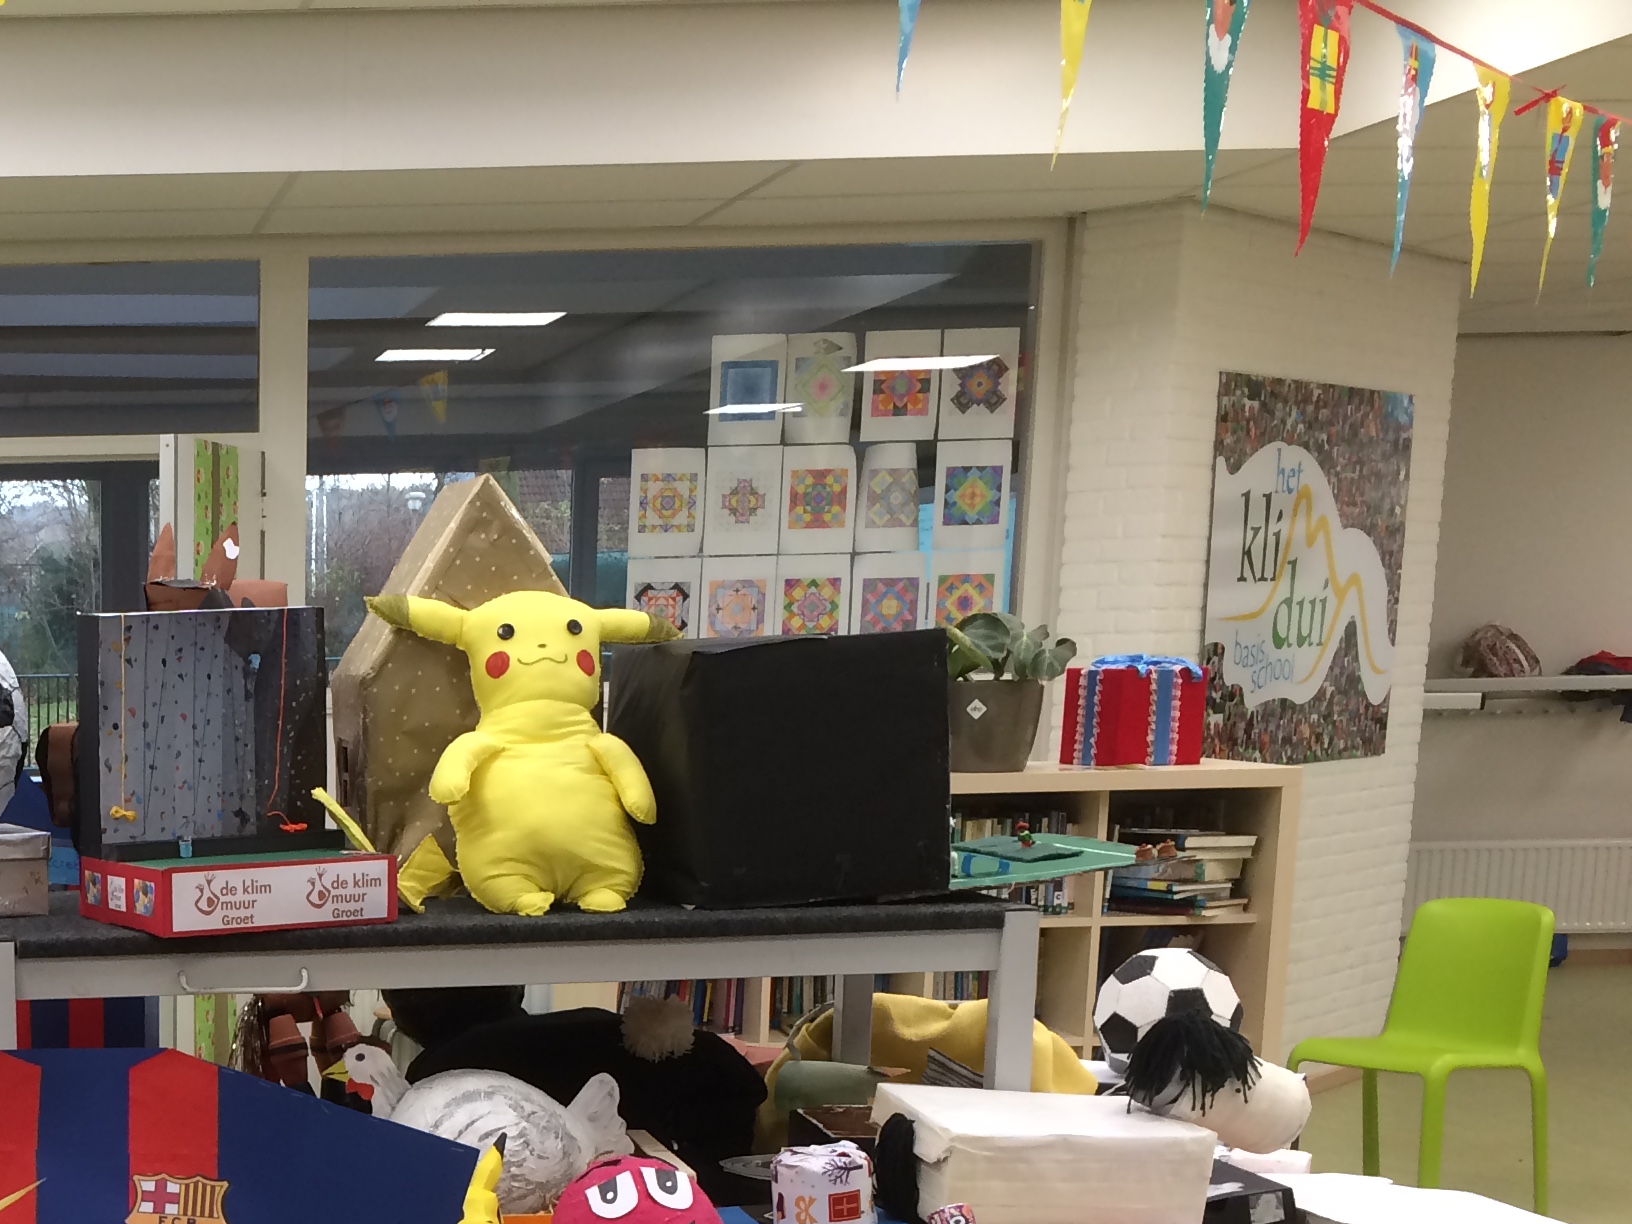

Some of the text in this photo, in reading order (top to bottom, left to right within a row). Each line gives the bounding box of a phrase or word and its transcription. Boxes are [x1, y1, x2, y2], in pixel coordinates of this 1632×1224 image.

[1274, 448, 1304, 494] het
[1234, 629, 1267, 668] basis
[1250, 653, 1296, 693] school
[220, 879, 272, 897] de klim
[331, 873, 382, 890] de klim
[220, 898, 258, 911] muur
[331, 891, 368, 904] muur
[221, 913, 255, 926] Groet
[332, 906, 364, 919] Groet
